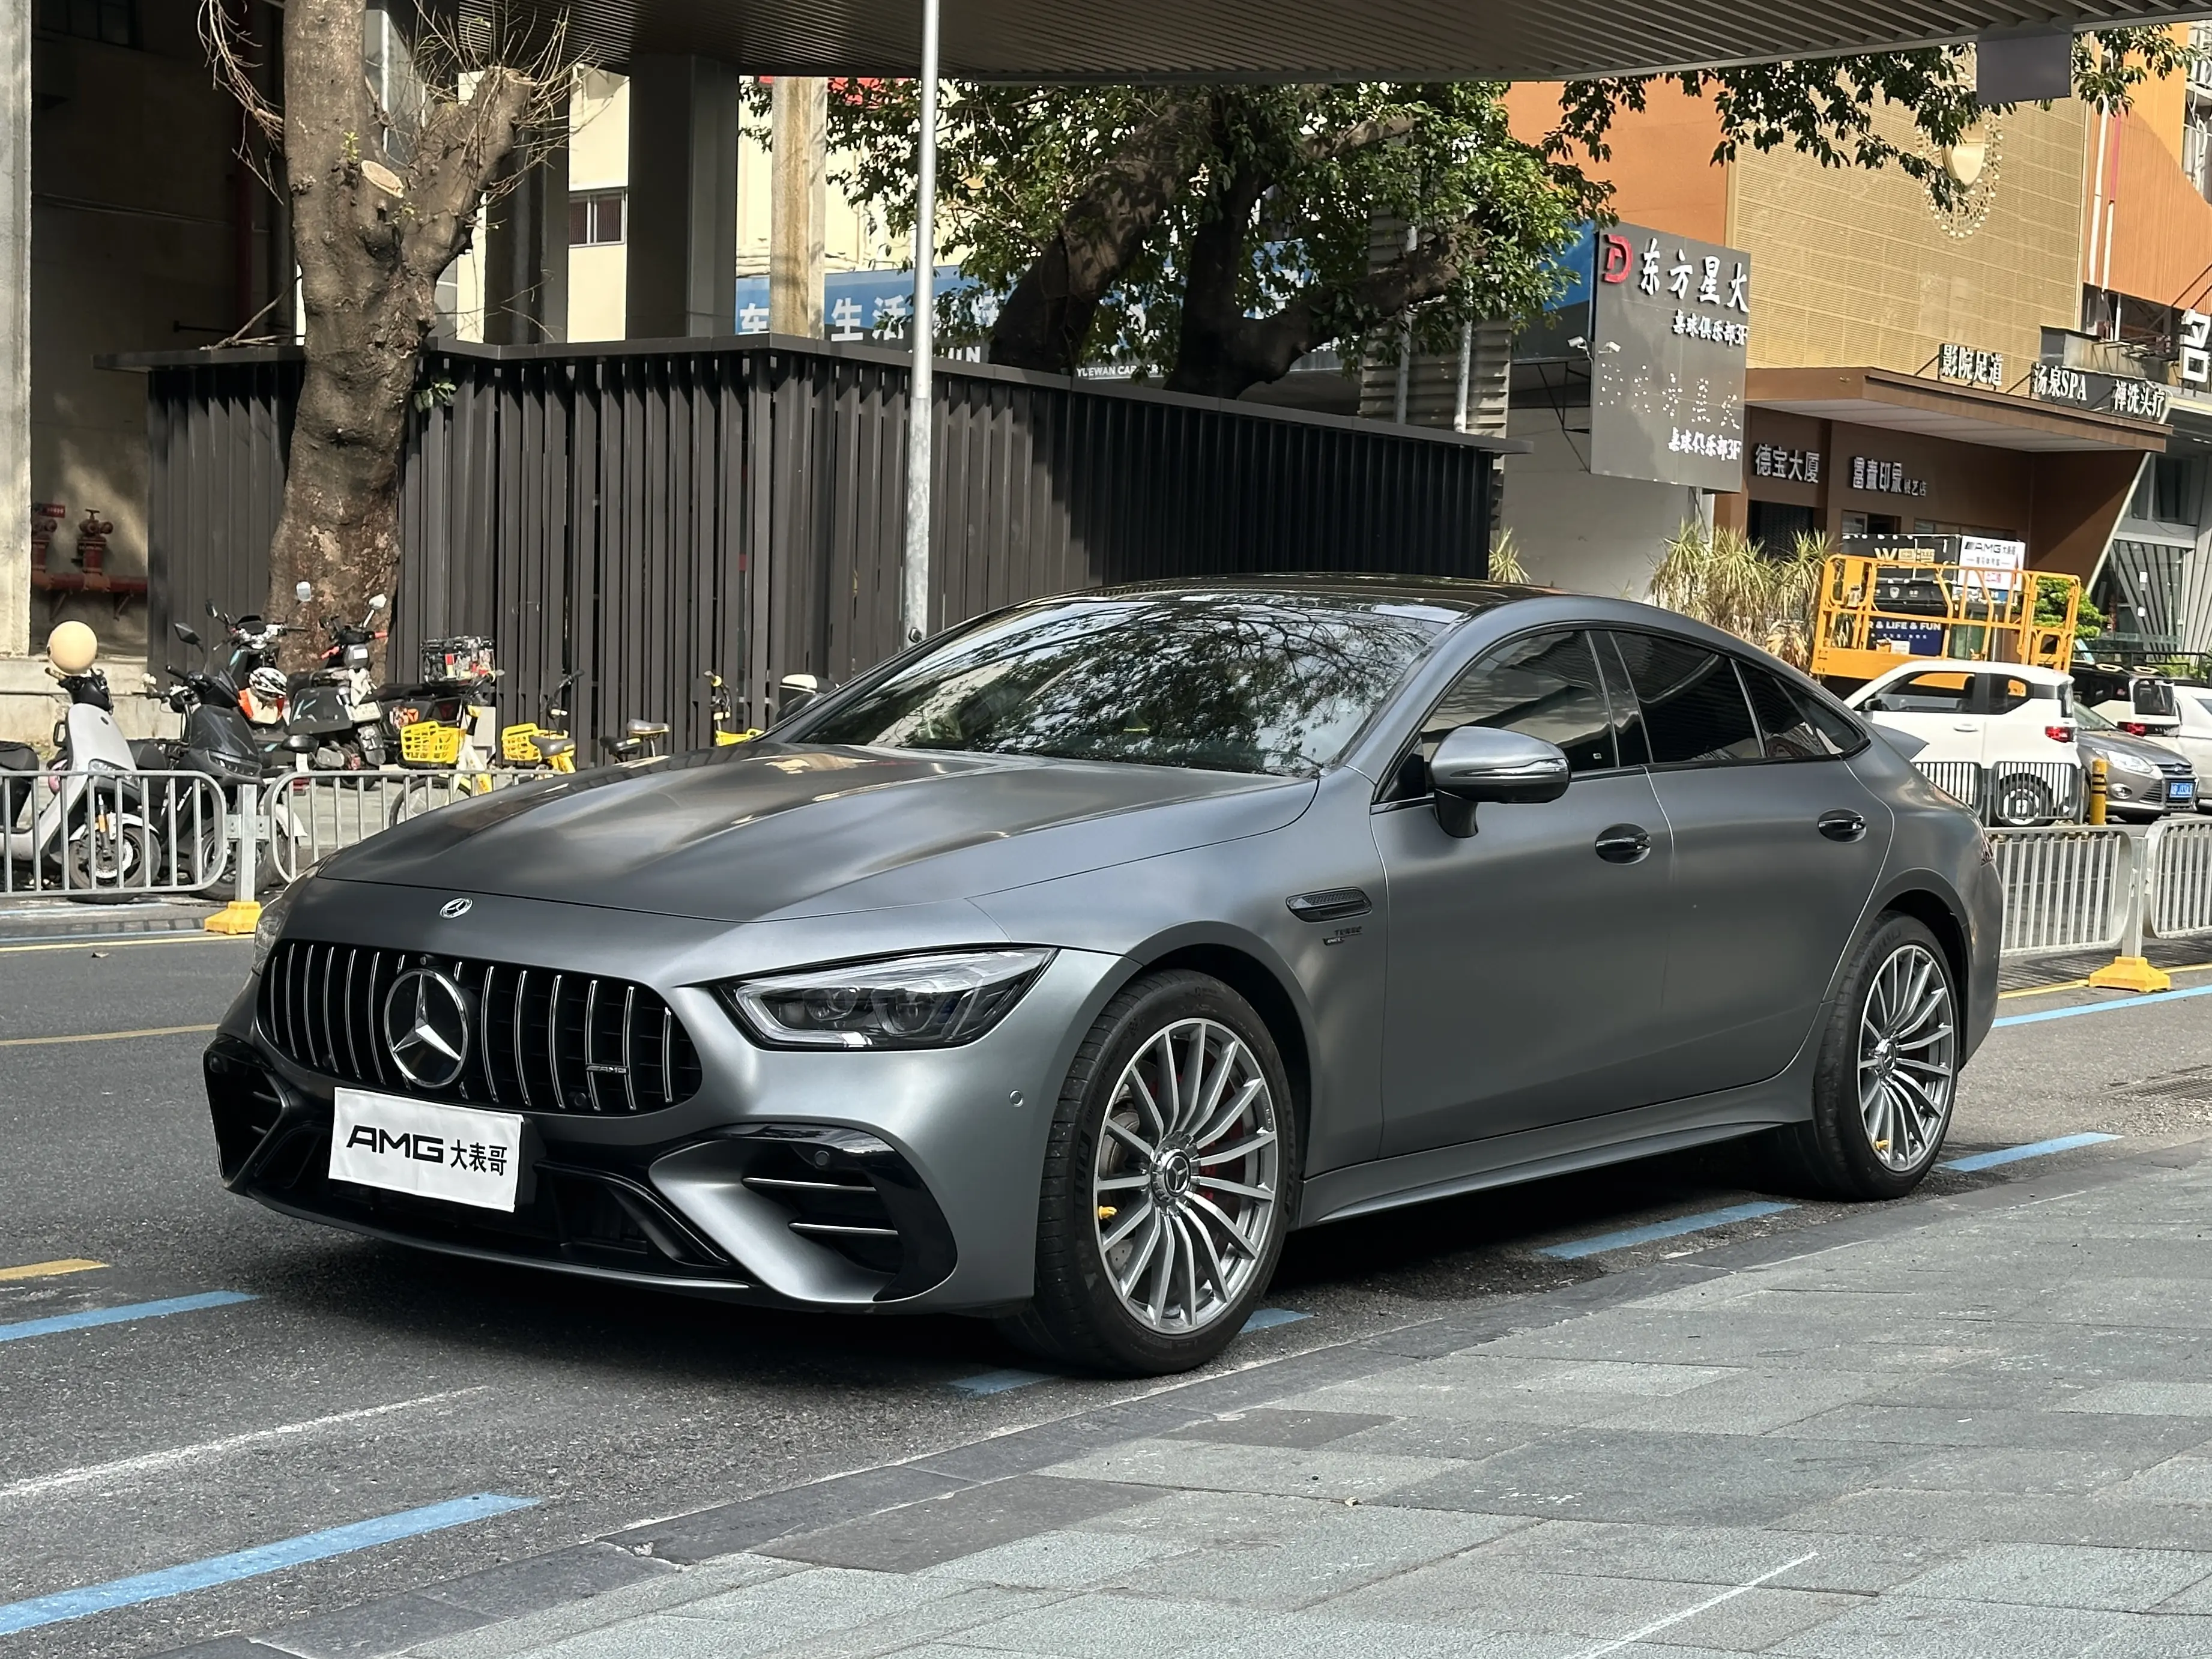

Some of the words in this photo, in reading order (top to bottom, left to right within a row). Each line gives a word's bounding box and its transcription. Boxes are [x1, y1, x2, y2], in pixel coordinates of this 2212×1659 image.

[1640, 238, 1750, 313] 东方星火
[1673, 309, 1749, 346] 桌球俱乐部3F
[1942, 344, 2004, 386] 影院足道
[2032, 362, 2087, 401] 汤泉SPA
[2115, 379, 2165, 418] 禅洗头疗
[1755, 444, 1820, 483] 德宝大厦
[1974, 542, 2001, 553] AMG
[346, 1125, 444, 1164] AMG
[450, 1139, 507, 1176] 大表哥
